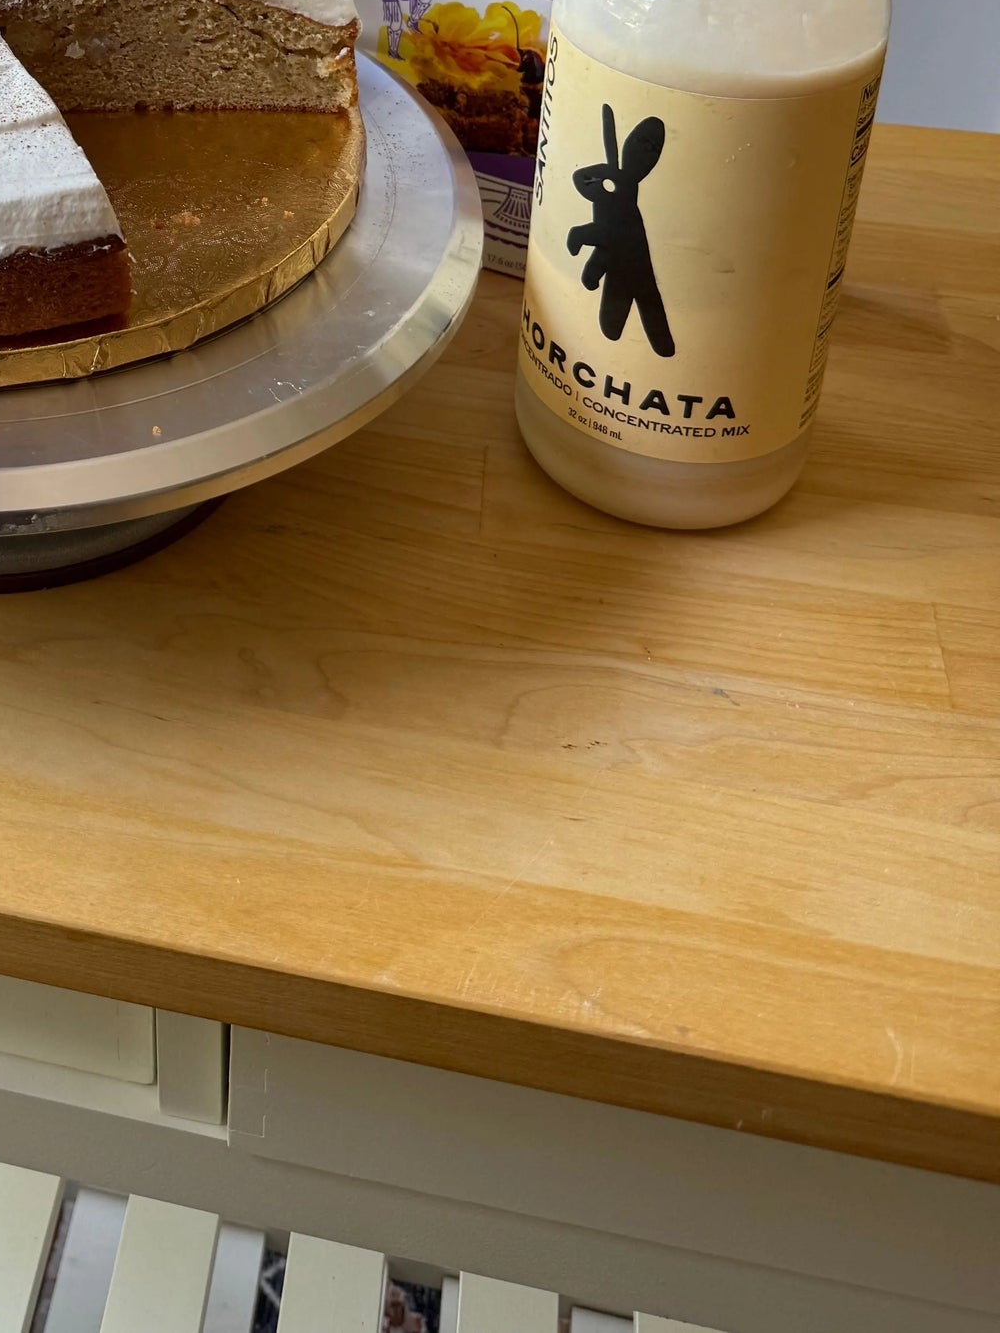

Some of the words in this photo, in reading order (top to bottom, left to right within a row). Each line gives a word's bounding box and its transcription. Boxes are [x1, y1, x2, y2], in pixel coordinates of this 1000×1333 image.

[535, 31, 559, 207] SANTITOS
[523, 299, 737, 420] HORCHATA
[567, 407, 578, 419] 32
[578, 415, 588, 426] oz
[609, 430, 623, 441] mL
[582, 396, 717, 438] CONCENTRATED
[721, 424, 751, 438] MIX
